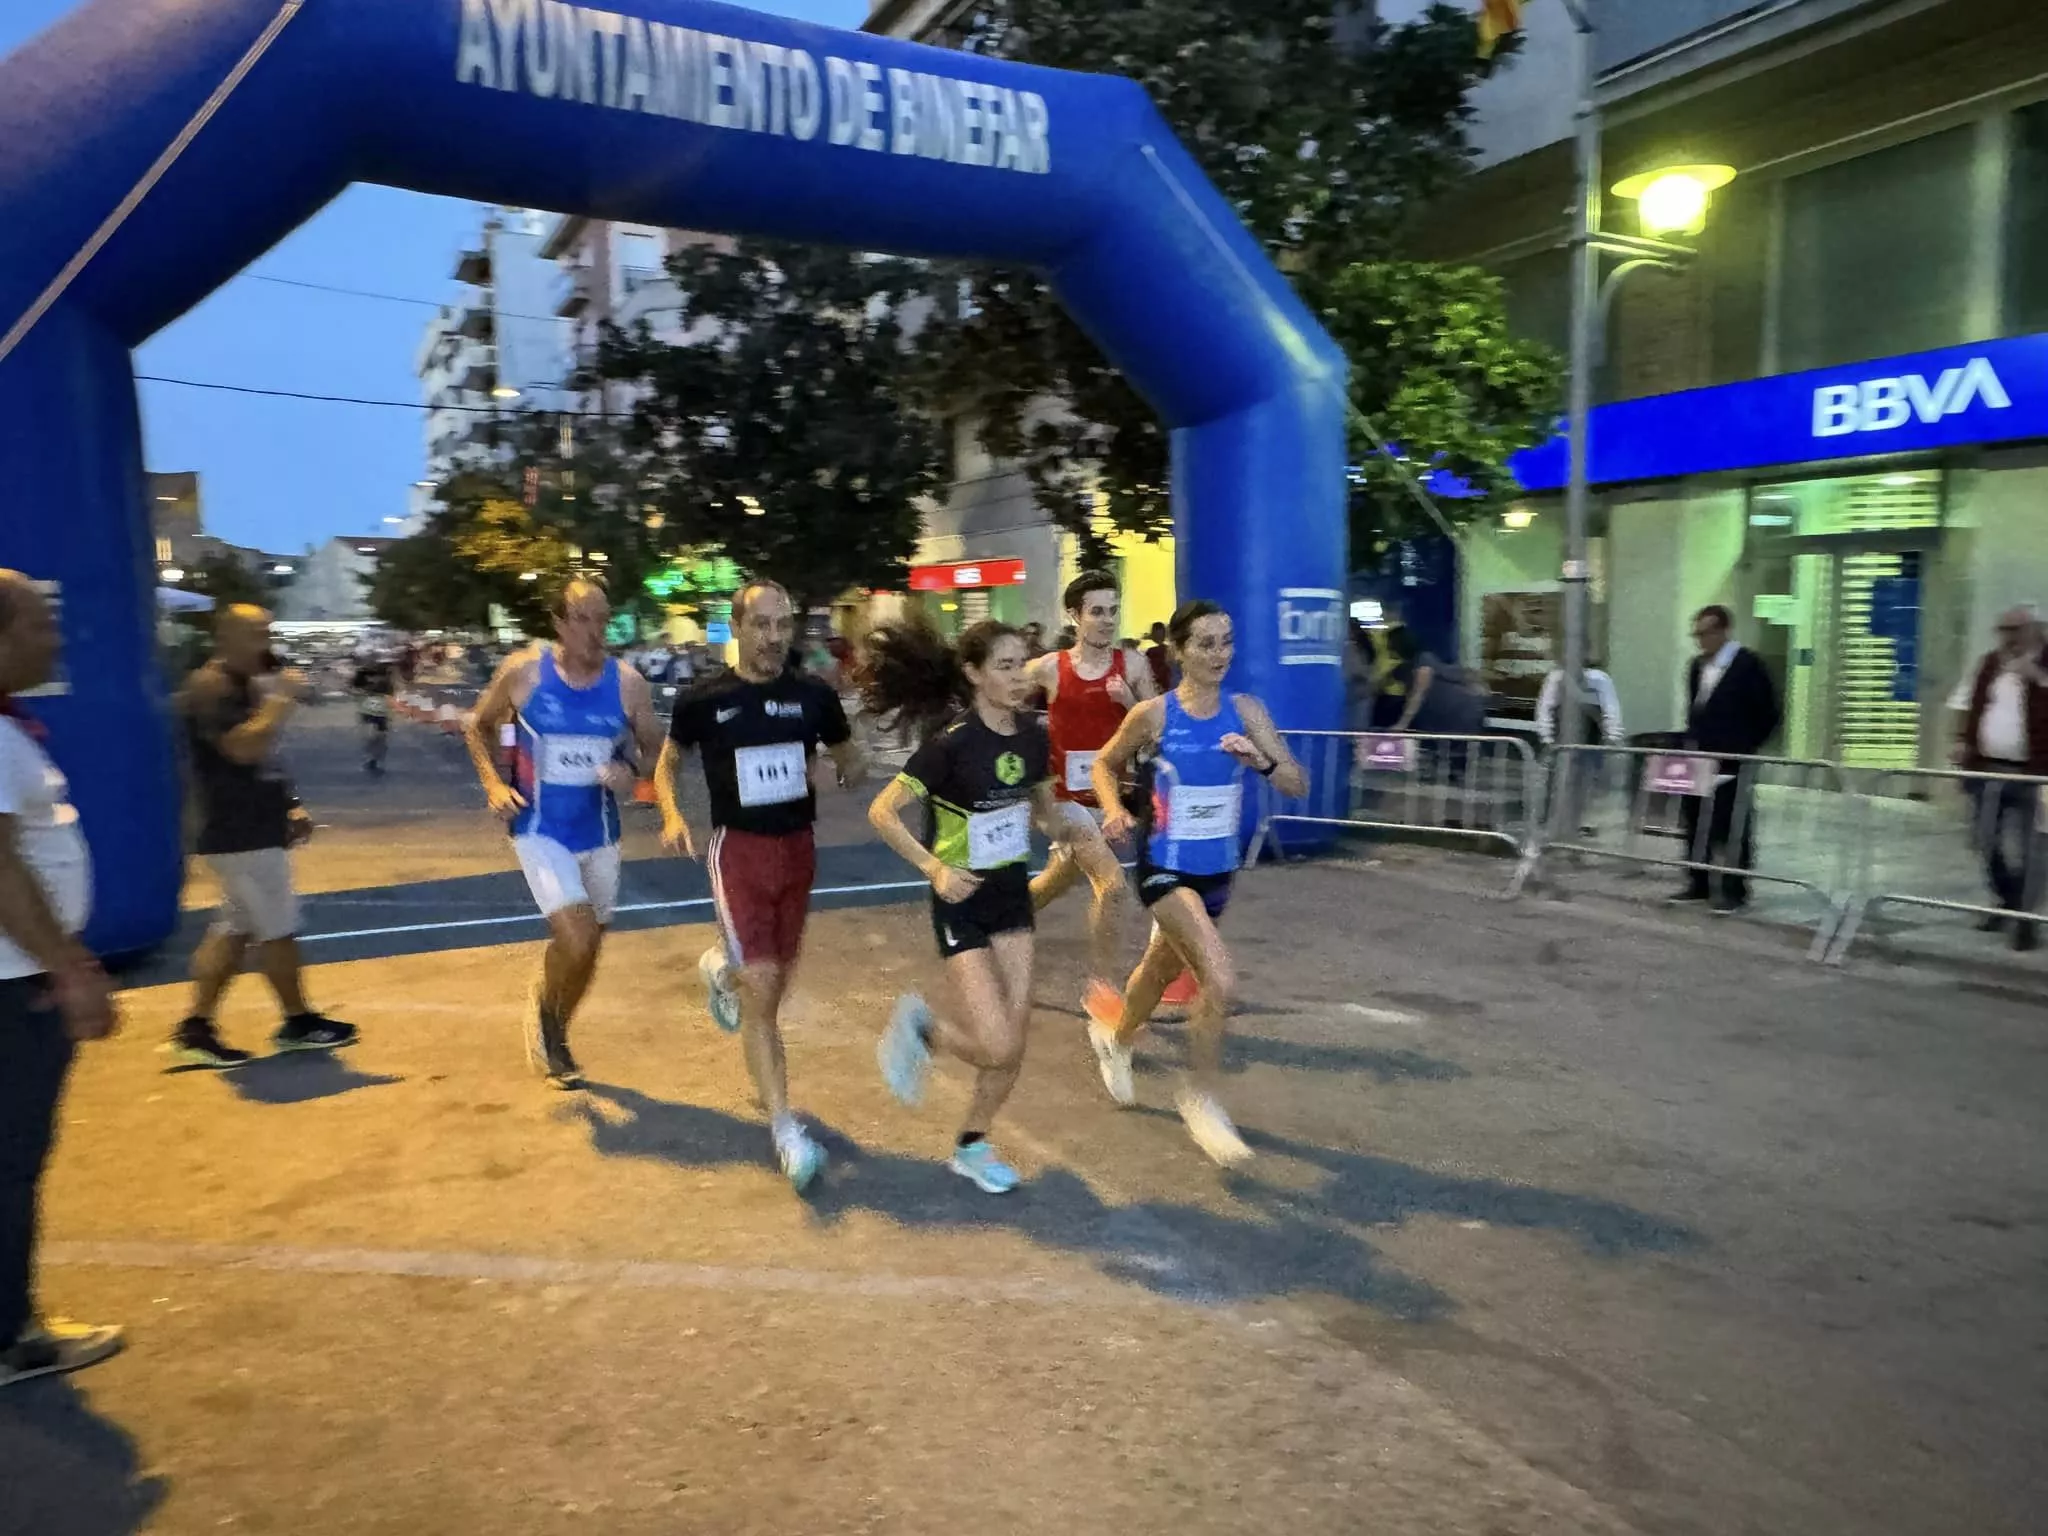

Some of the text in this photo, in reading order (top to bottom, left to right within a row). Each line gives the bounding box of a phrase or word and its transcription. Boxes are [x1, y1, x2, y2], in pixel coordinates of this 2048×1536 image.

[456, 0, 1051, 174] AYUNTAMIENTO DE BINEFAR
[1811, 357, 2013, 437] BBVA
